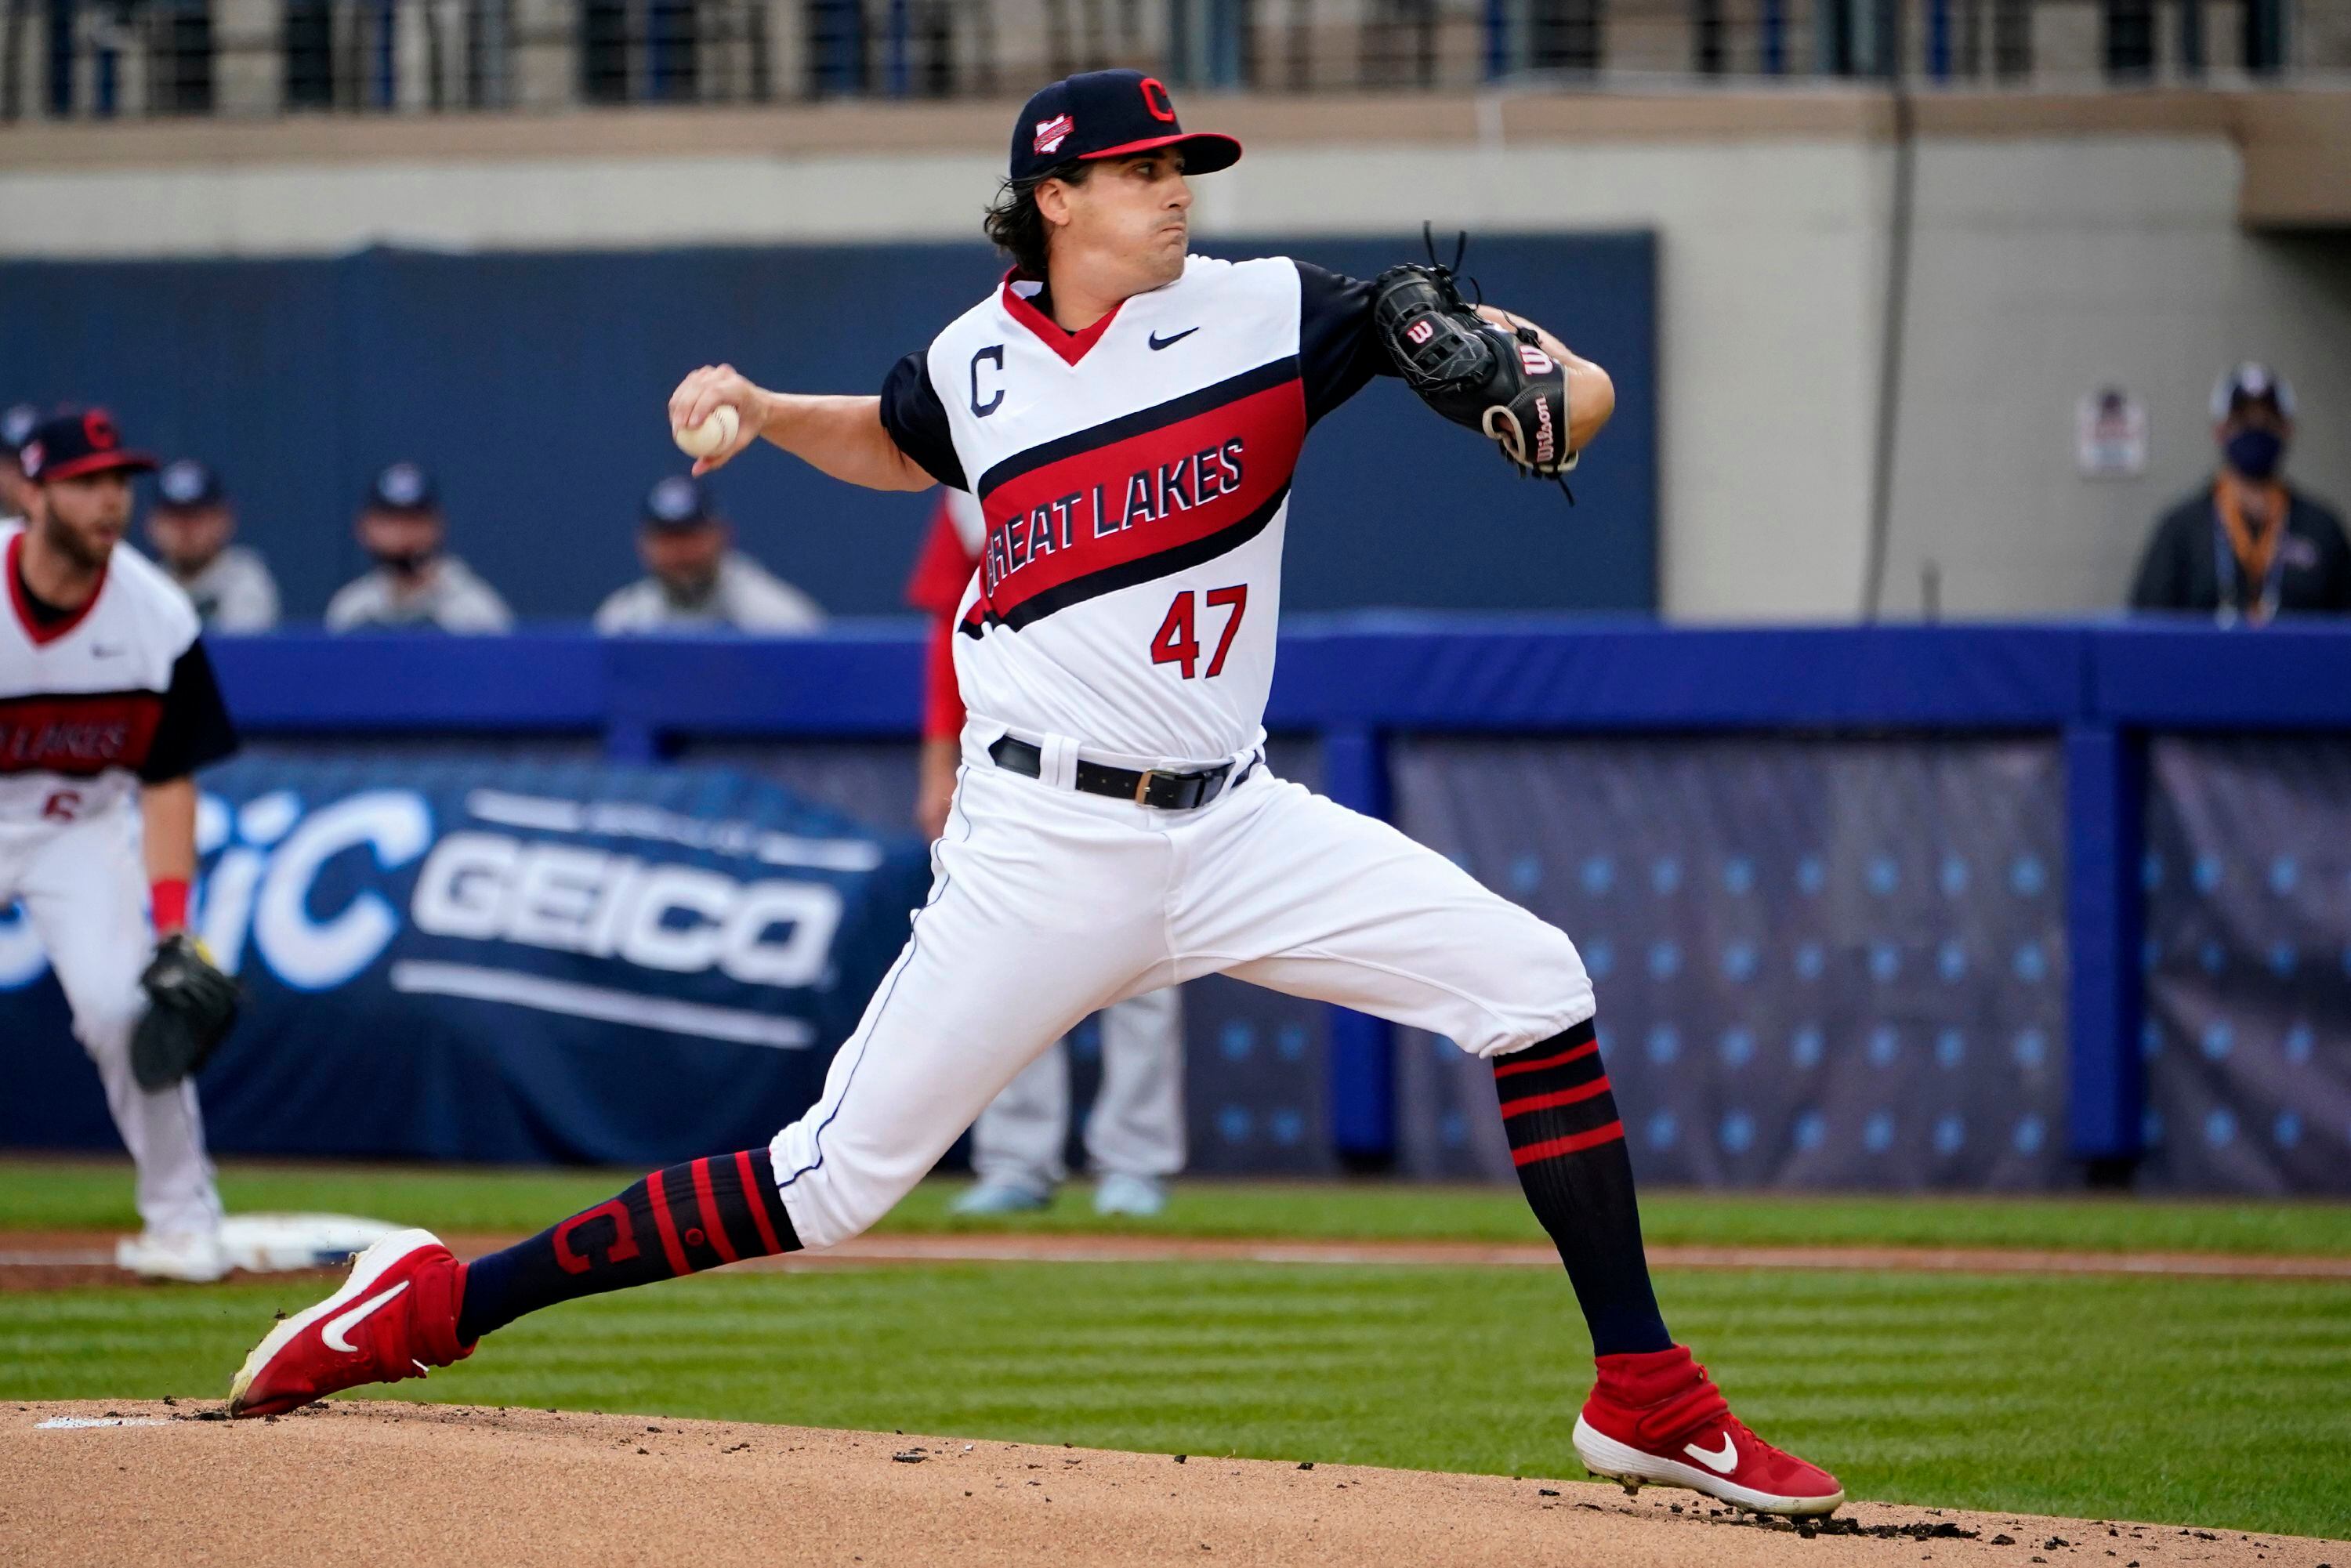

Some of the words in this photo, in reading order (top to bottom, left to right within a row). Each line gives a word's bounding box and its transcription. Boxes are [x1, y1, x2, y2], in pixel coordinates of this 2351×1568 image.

[1139, 78, 1176, 123] C
[970, 344, 1005, 418] C
[1535, 393, 1555, 463] Wilson
[1093, 436, 1244, 540] LAKES
[1150, 583, 1248, 679] 47
[412, 831, 843, 989] GEICO
[552, 1199, 640, 1276] C
